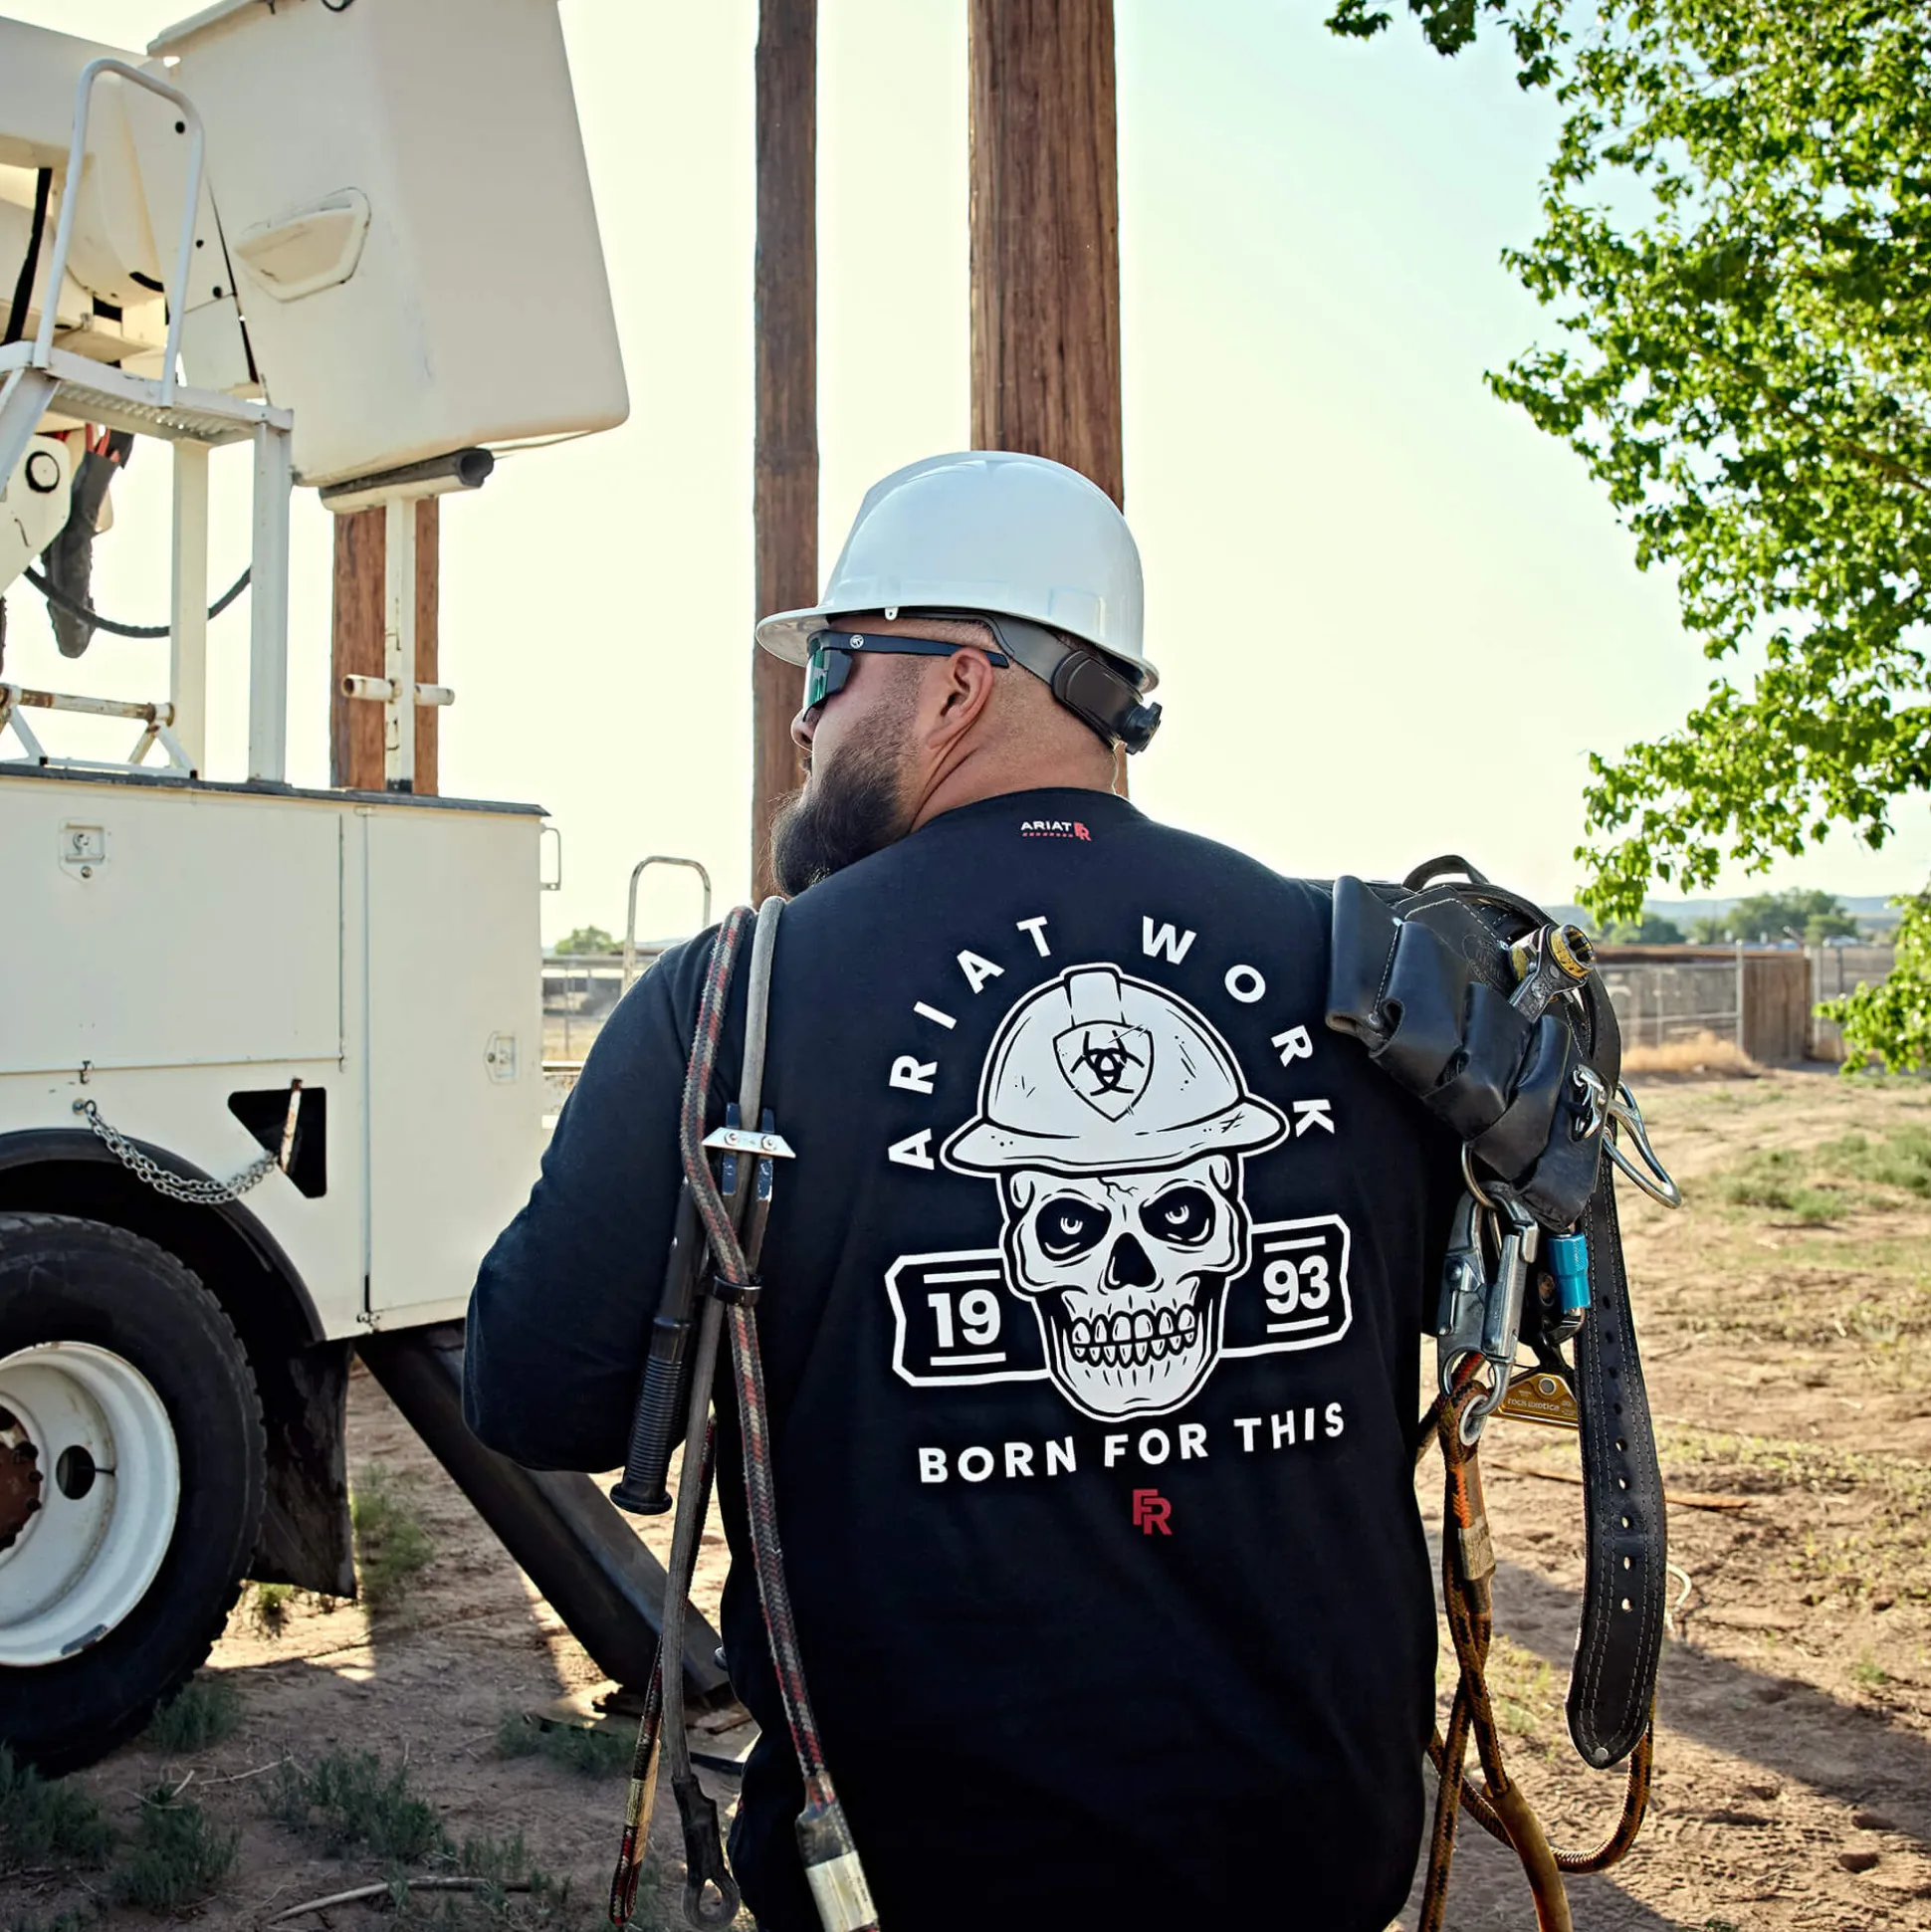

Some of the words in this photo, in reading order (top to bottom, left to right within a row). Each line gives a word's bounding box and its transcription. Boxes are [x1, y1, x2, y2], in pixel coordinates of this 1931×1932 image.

[1020, 820, 1072, 831] ARIAT
[888, 916, 1051, 1171] ARIAT
[1142, 915, 1335, 1138] WORK
[927, 1289, 1001, 1348] 19
[1263, 1254, 1331, 1315] 93
[918, 1435, 1077, 1483] BORN
[1104, 1422, 1208, 1468] FOR
[1233, 1401, 1344, 1452] THIS
[1132, 1488, 1173, 1536] FR
